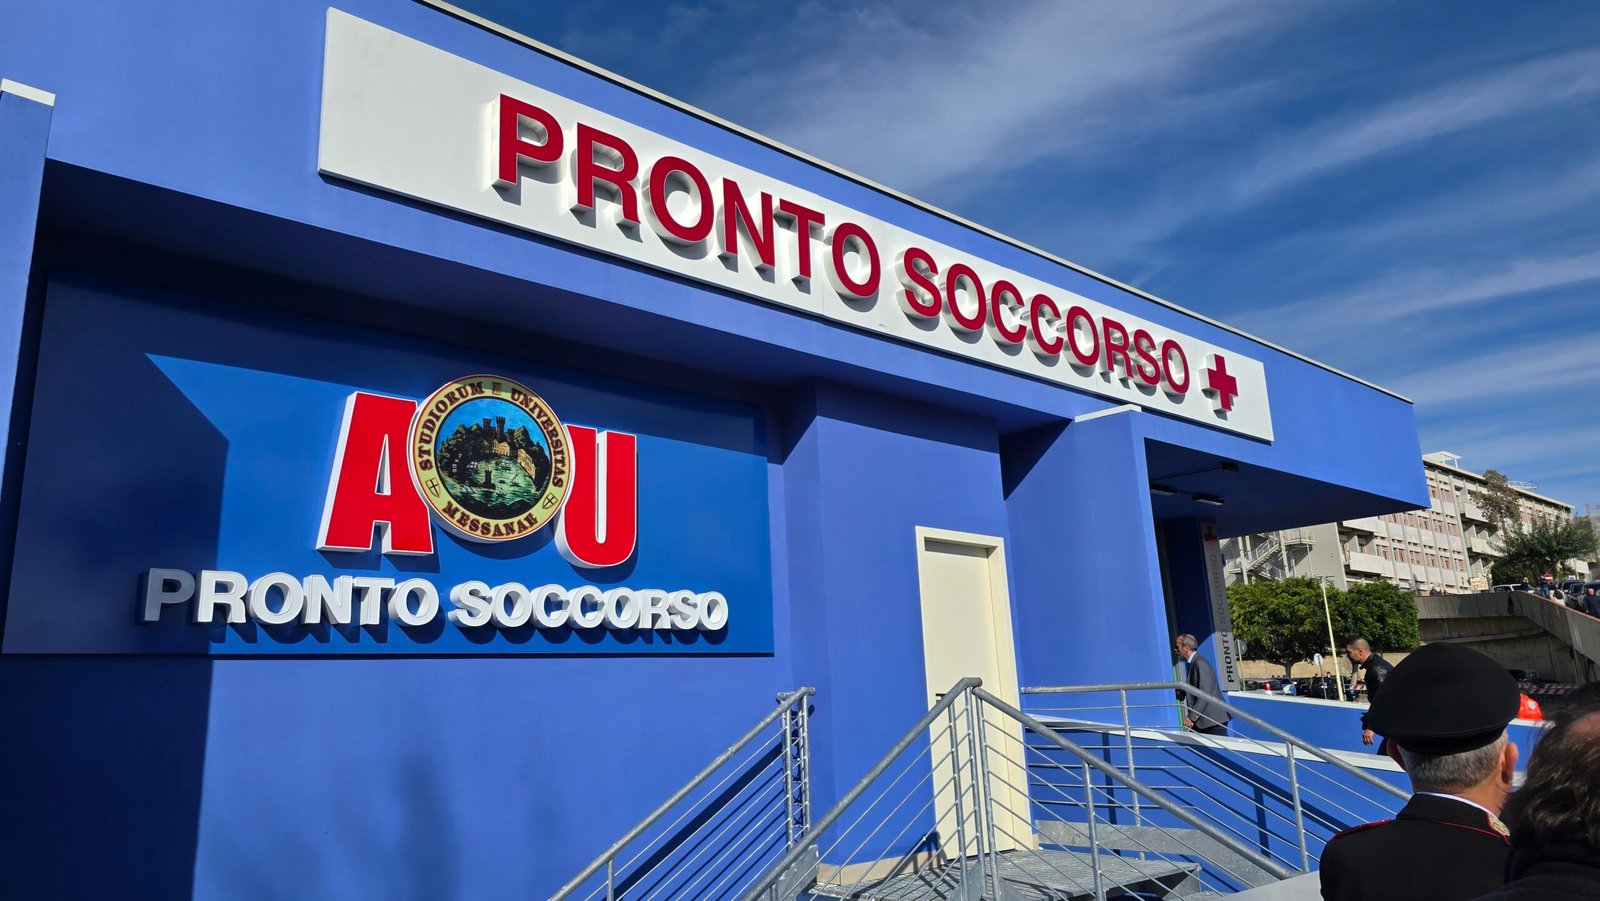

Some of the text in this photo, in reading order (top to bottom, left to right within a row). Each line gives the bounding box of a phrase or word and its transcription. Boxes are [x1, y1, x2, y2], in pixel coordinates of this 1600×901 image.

[499, 93, 1190, 395] PRONTO SOCCORSO
[419, 382, 566, 488] STUDIORUM UNIVERSITAS
[442, 500, 539, 537] MESSANAE
[144, 568, 728, 631] PRONTO SOCCORSO
[1221, 629, 1235, 683] PRONTO
